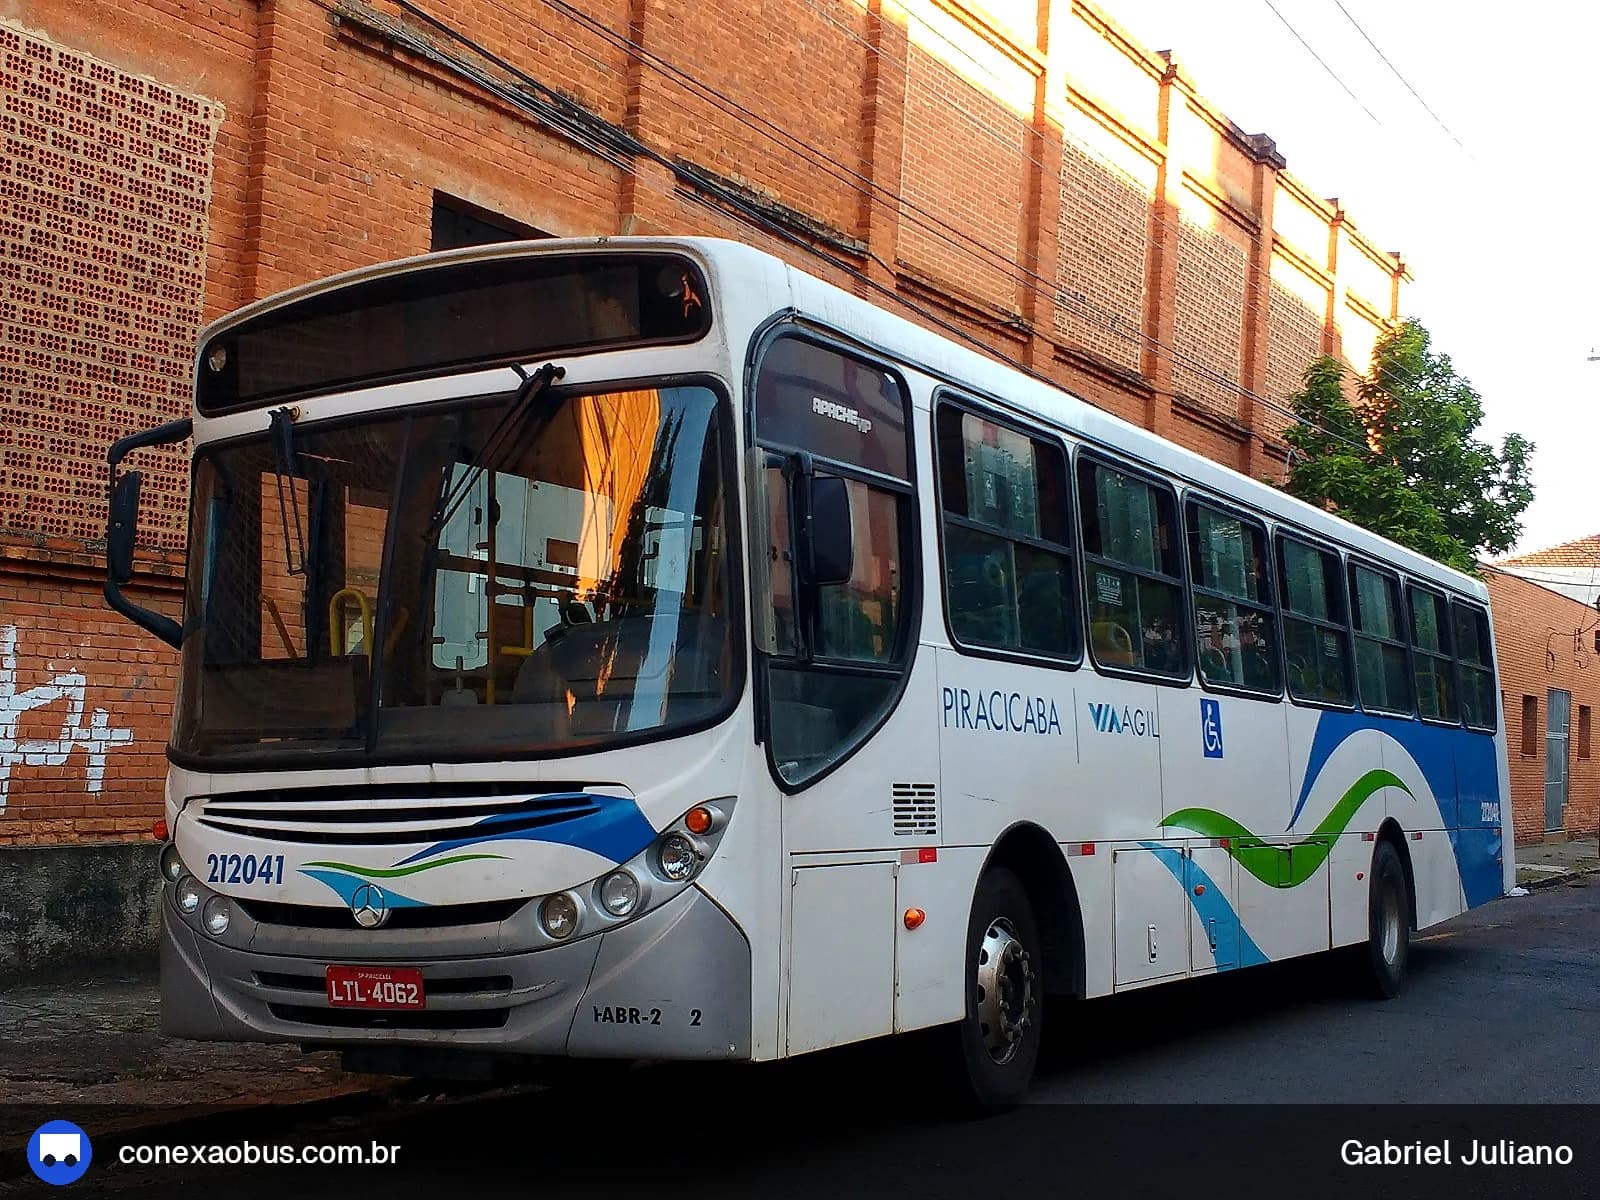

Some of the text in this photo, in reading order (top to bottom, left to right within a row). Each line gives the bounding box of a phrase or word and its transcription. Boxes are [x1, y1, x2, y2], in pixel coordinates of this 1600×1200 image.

[812, 397, 859, 425] APACHE
[942, 687, 1062, 735] PIRACICABA
[207, 853, 285, 885] 212041
